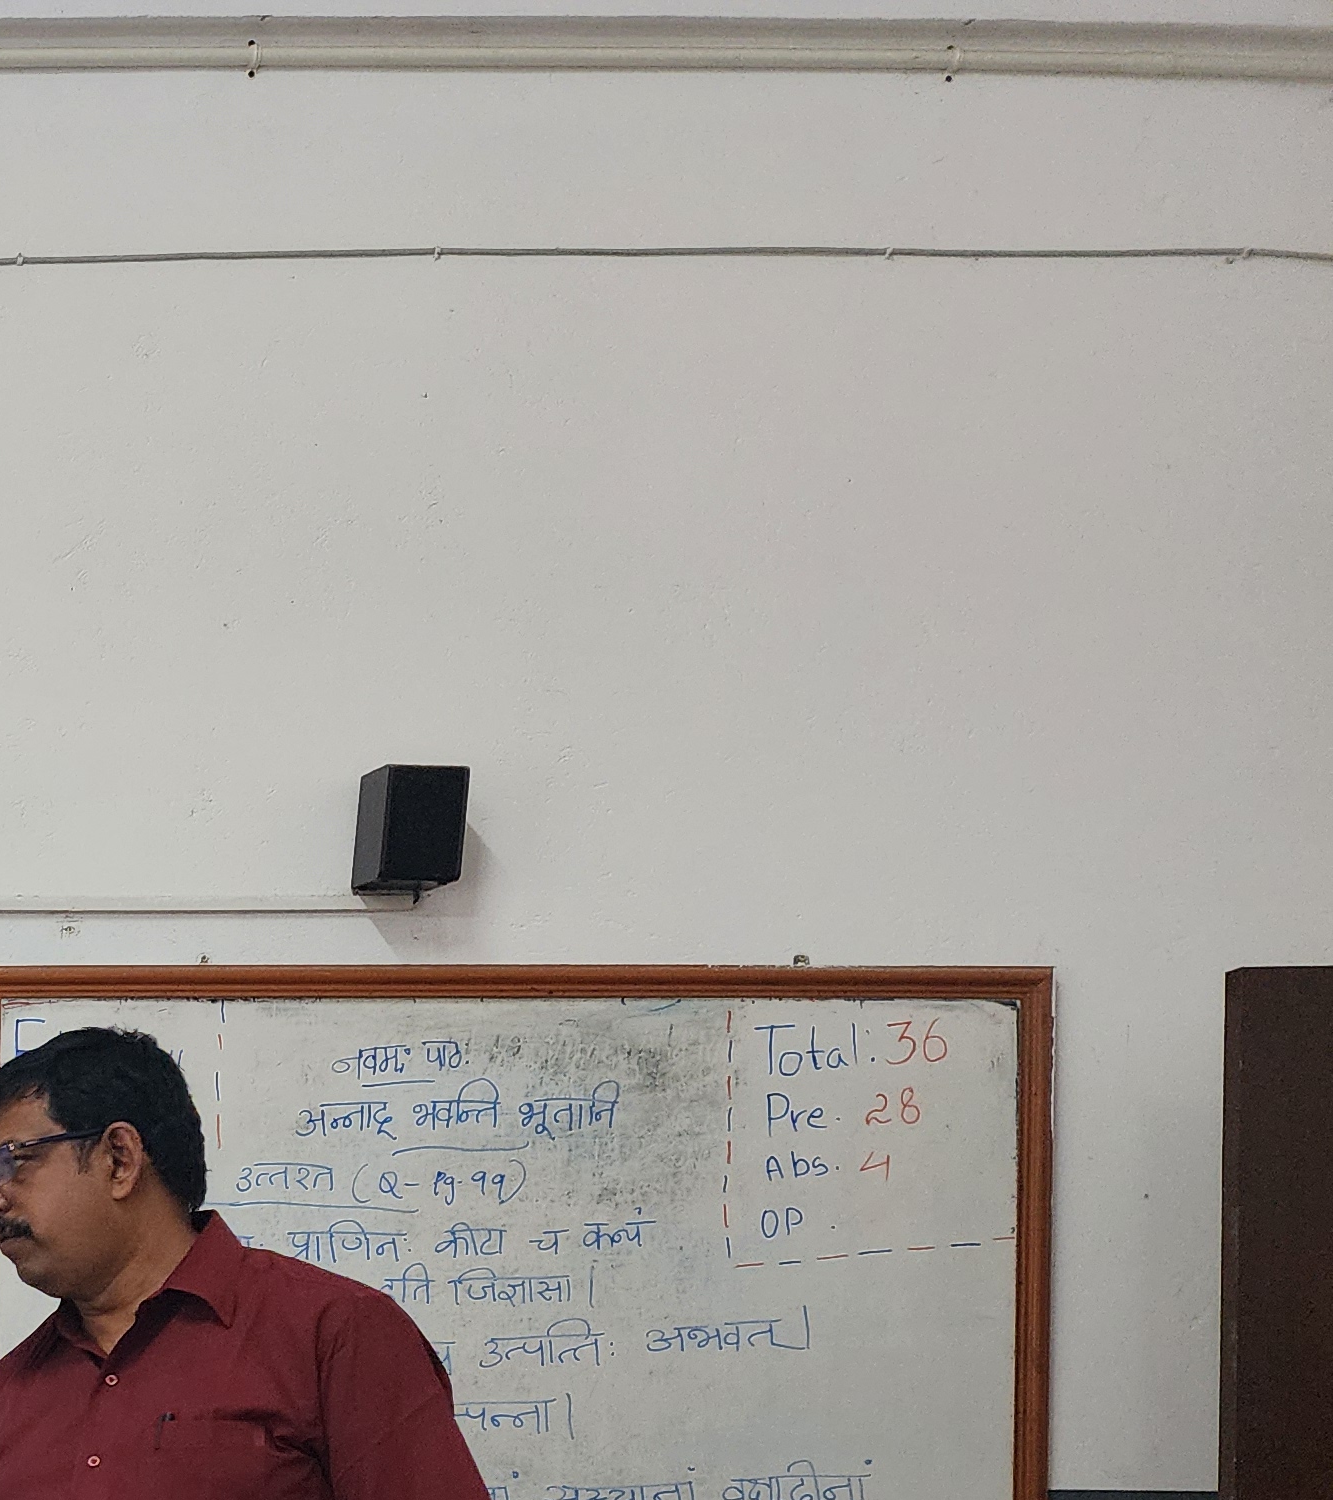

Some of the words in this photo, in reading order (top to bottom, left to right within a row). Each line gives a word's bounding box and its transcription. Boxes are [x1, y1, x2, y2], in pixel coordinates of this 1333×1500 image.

[886, 1017, 948, 1065] 36
[413, 1077, 502, 1131] भवन्ति
[519, 1080, 621, 1141] भूतानि
[865, 1086, 921, 1126] 28
[859, 1151, 891, 1182] 4
[286, 1219, 412, 1264] प्राणिनः
[529, 1228, 570, 1256] च
